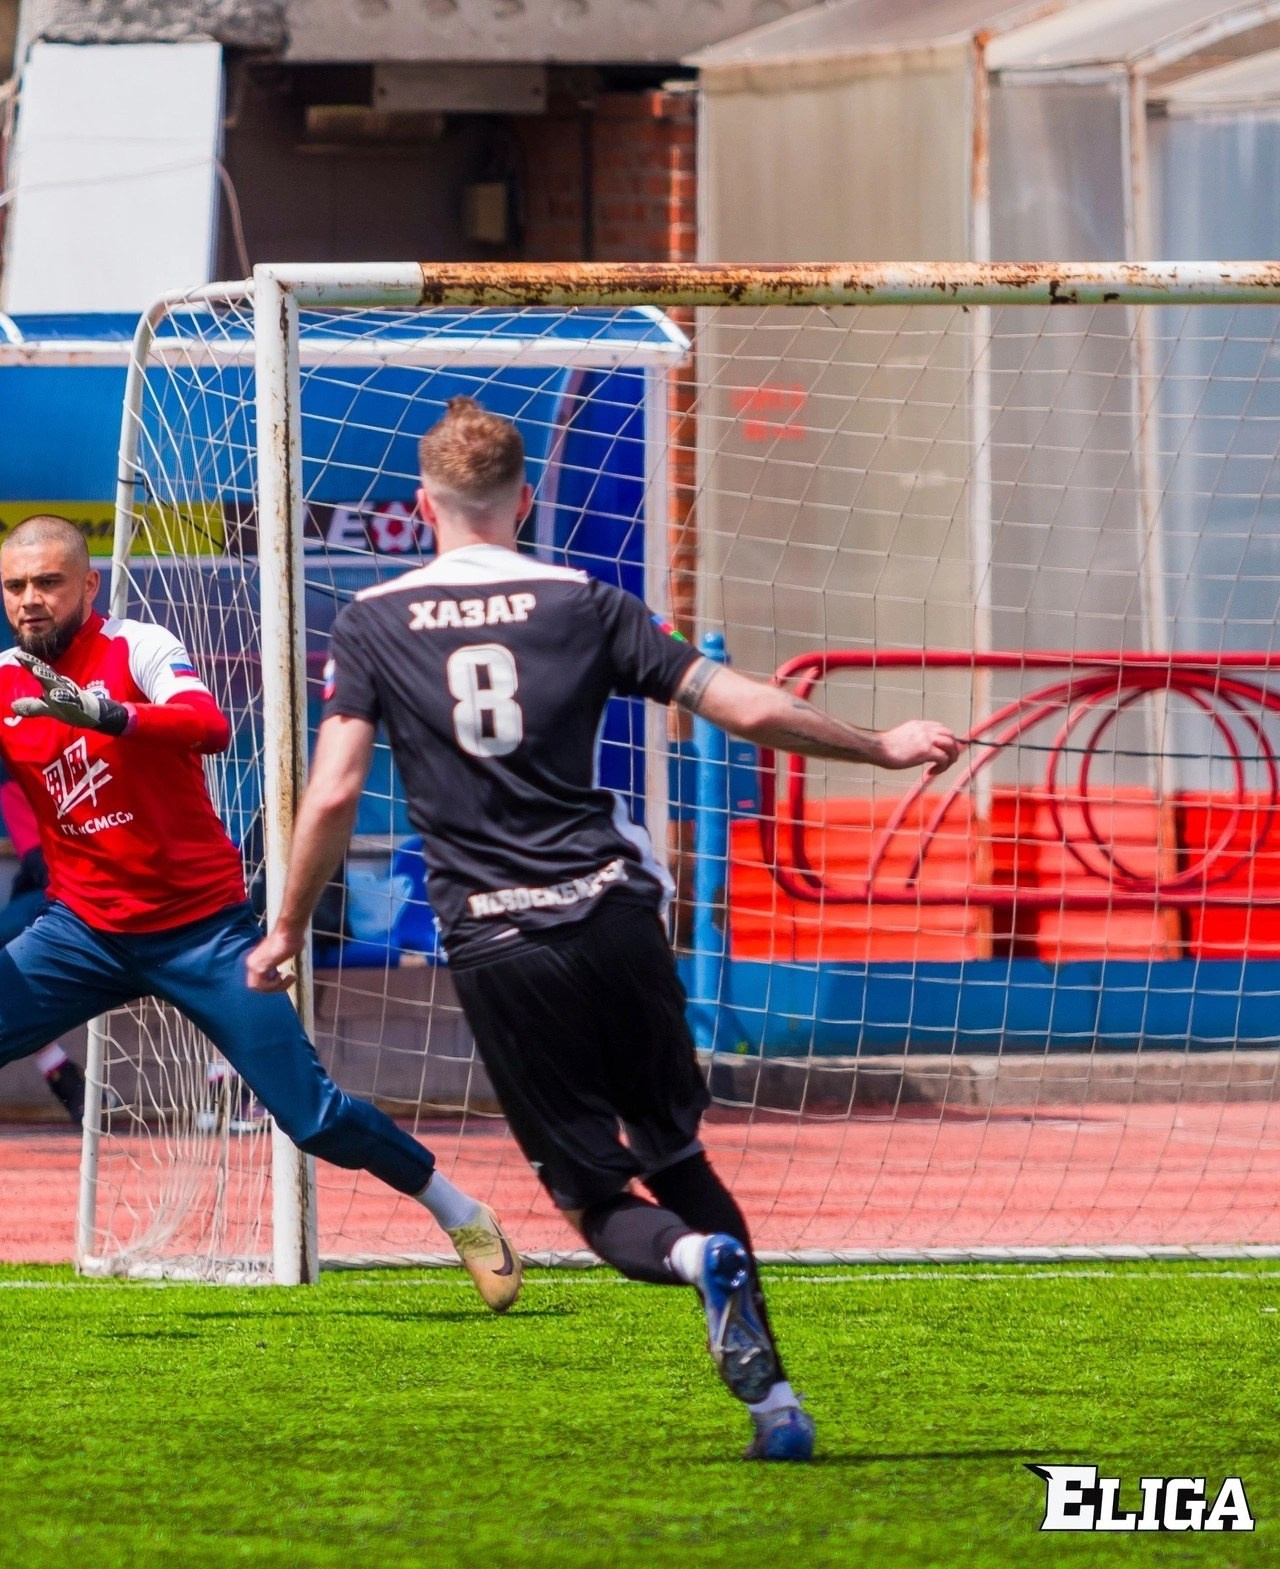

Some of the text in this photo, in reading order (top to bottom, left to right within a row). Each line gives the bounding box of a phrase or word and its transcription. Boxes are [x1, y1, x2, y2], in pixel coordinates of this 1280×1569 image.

[408, 593, 537, 632] ХАЗАР
[446, 642, 524, 758] 8
[61, 823, 79, 836] ГК
